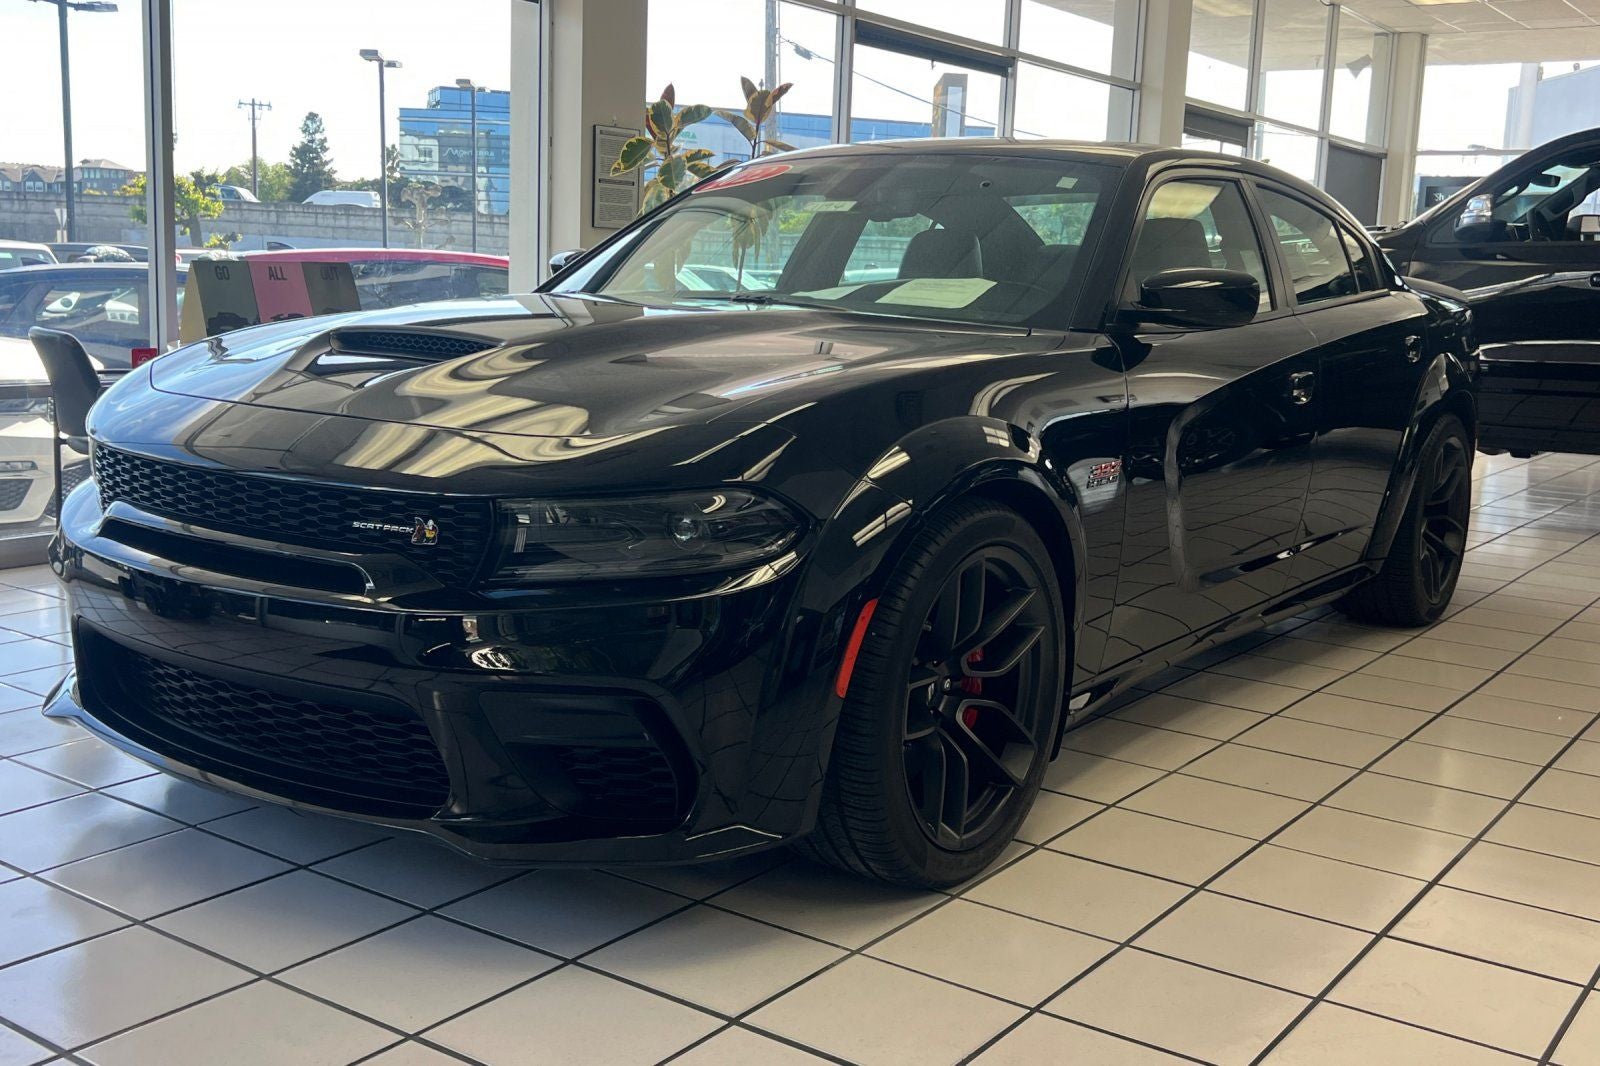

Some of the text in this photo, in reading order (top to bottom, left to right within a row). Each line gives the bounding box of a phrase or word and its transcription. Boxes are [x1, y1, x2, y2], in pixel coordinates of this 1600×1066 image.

[214, 266, 339, 281] GO ALL OUT
[353, 521, 415, 534] SCAT PACK
